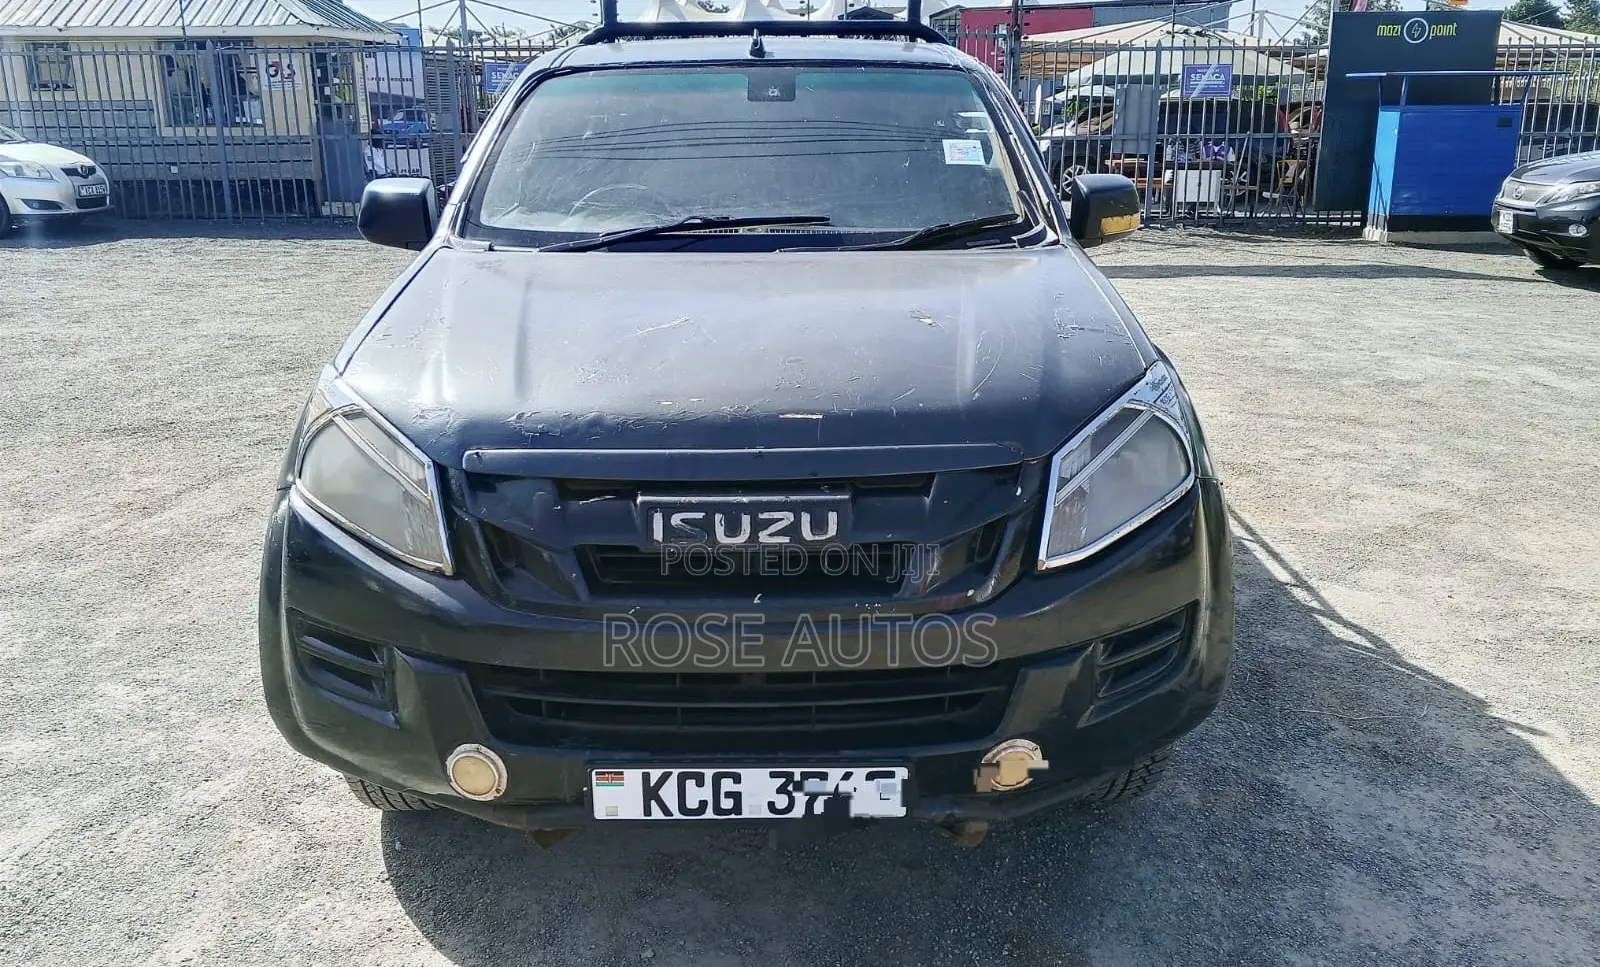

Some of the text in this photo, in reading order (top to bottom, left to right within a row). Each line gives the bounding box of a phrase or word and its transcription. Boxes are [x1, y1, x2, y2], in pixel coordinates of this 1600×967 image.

[1428, 22, 1458, 40] point
[491, 71, 520, 80] SENAC
[652, 510, 839, 545] ISUZU
[641, 770, 744, 817] KCG
